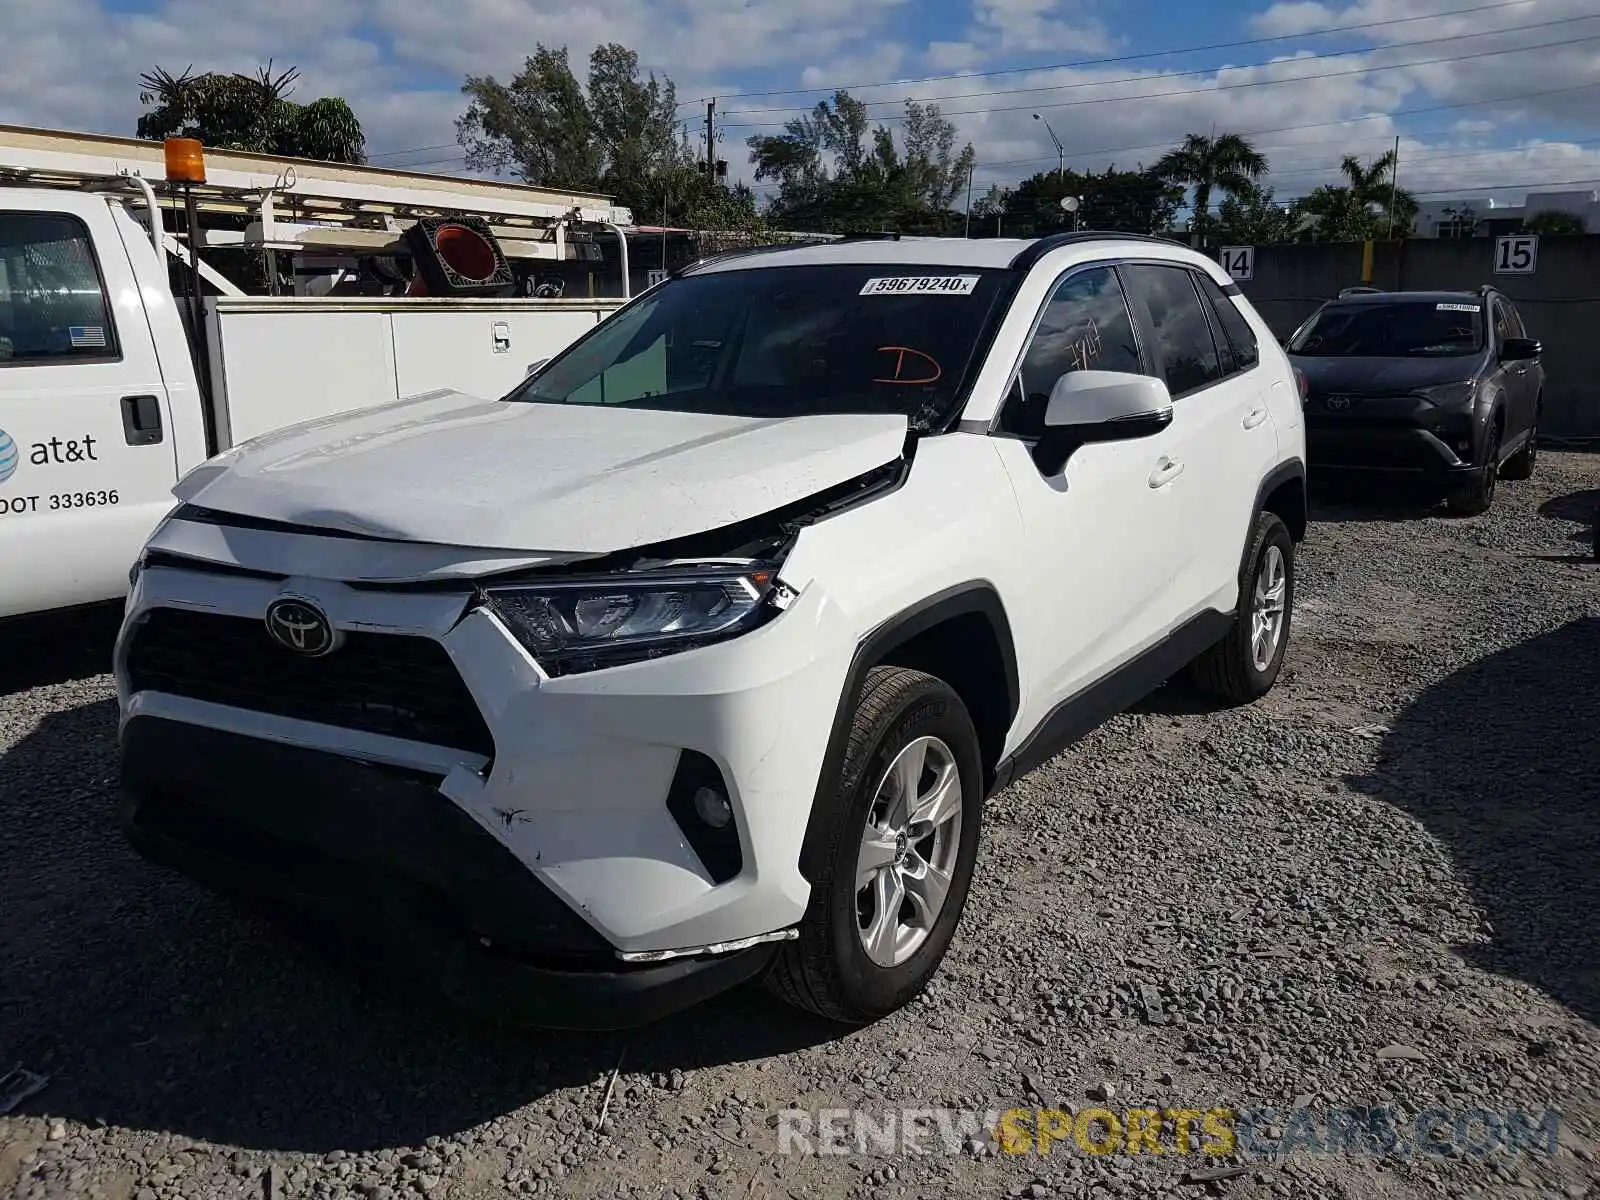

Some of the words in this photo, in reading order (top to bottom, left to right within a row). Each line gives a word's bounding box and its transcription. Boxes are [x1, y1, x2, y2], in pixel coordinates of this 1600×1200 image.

[1223, 250, 1250, 276] 14
[1500, 240, 1531, 269] 15
[872, 346, 942, 384] D
[30, 434, 98, 465] at&t
[49, 489, 119, 510] 333636
